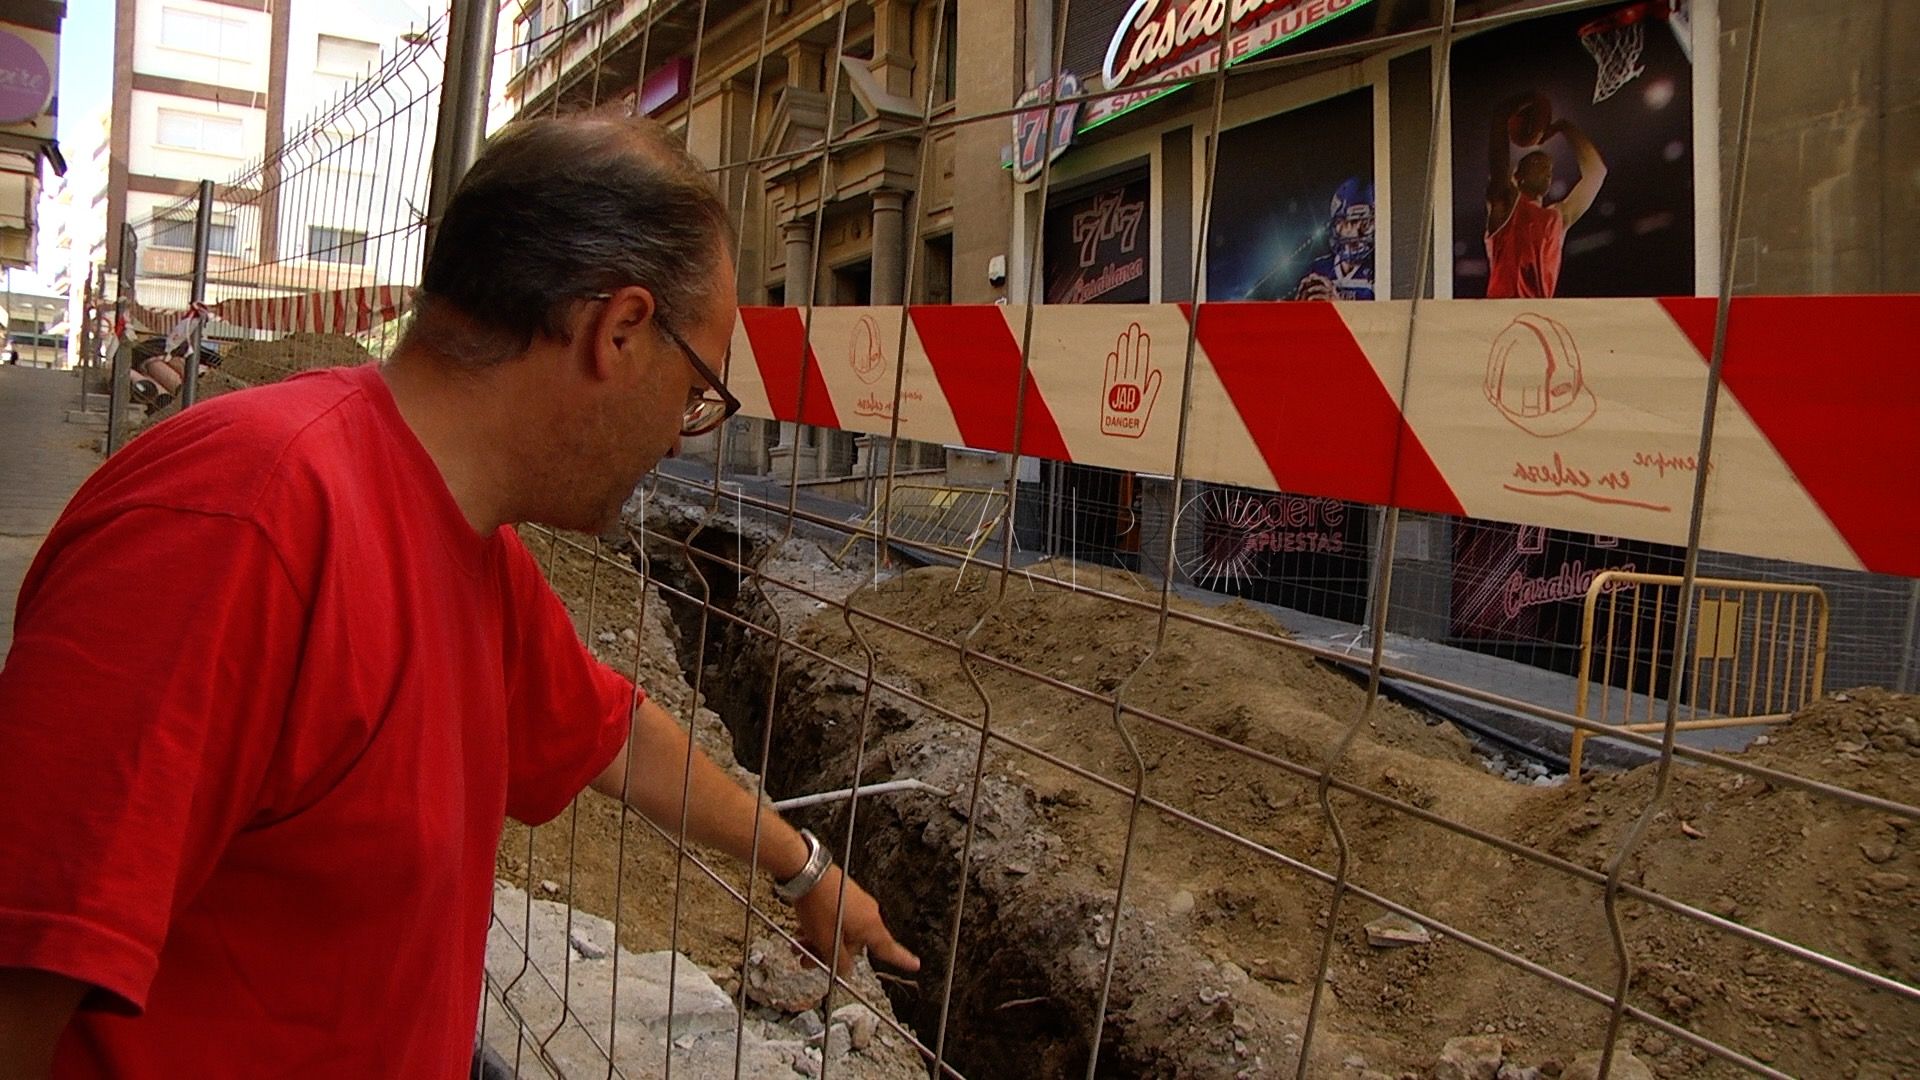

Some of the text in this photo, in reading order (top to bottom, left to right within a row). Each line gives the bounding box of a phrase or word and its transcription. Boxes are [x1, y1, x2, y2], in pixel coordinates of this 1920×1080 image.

[1073, 188, 1144, 268] 777
[1111, 386, 1136, 410] JAR
[1105, 415, 1139, 429] DANGER
